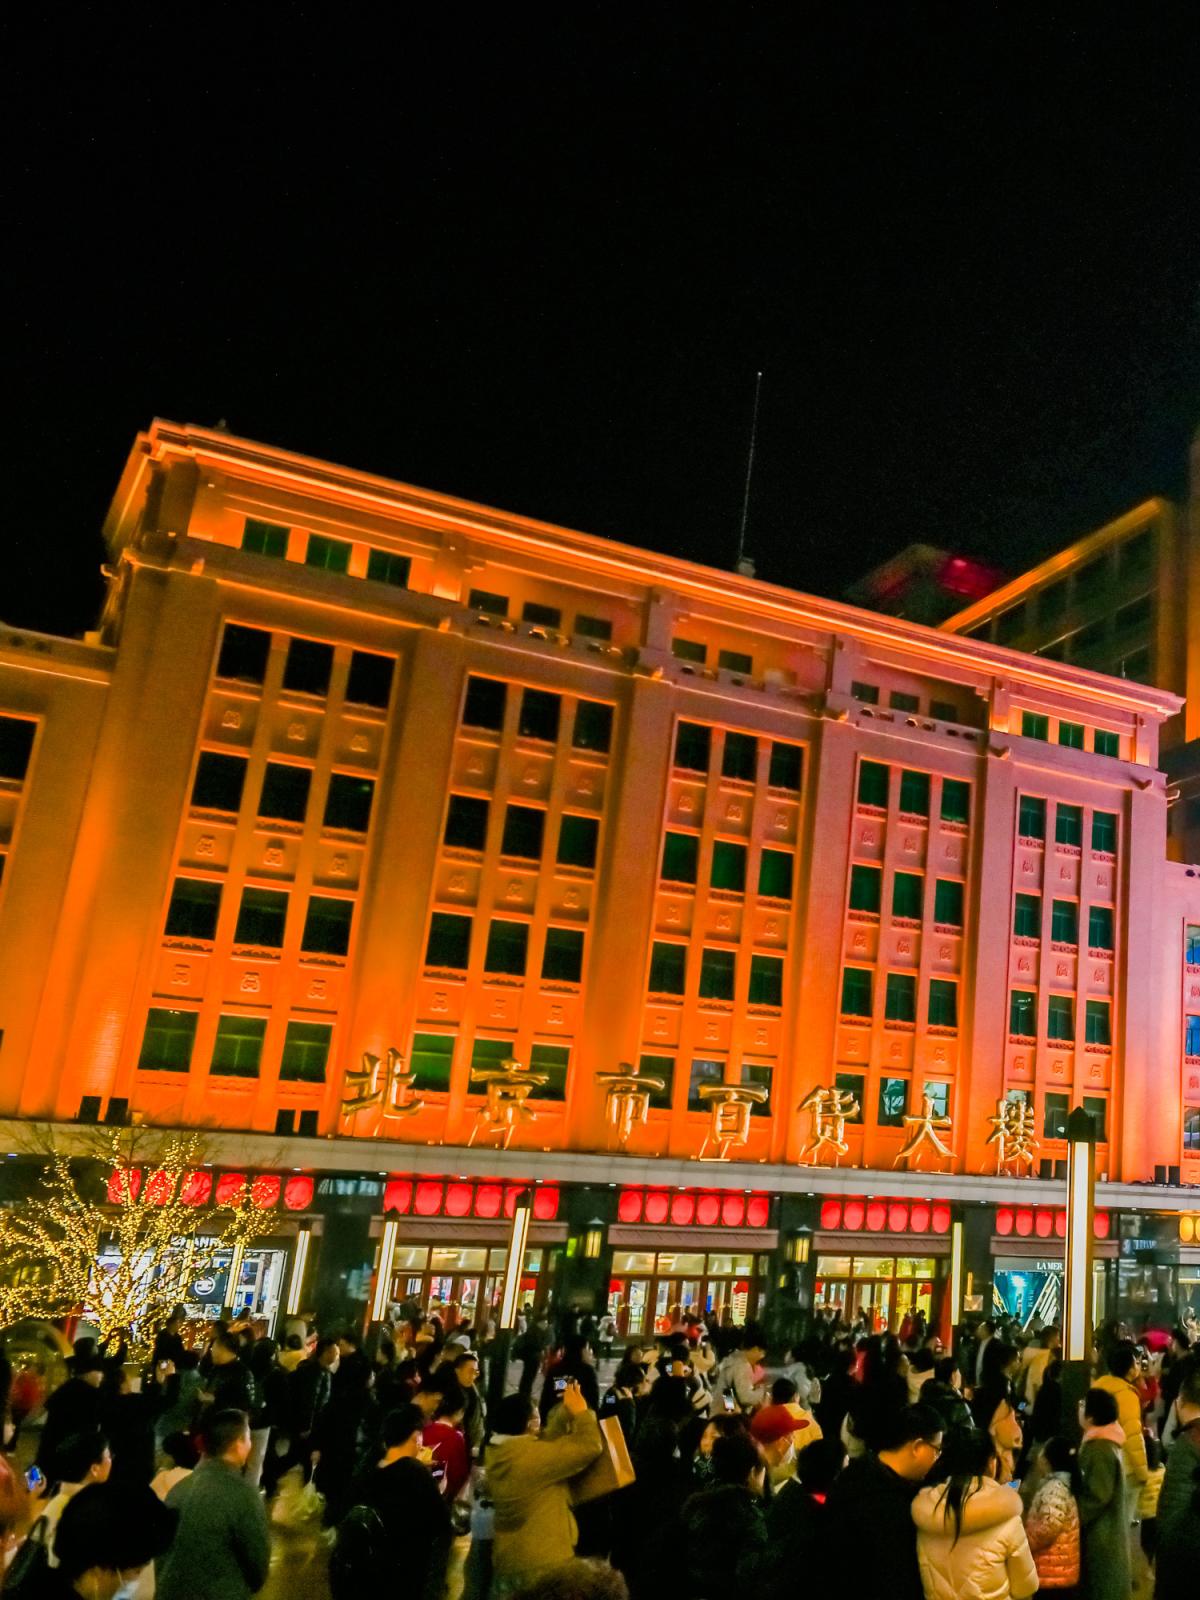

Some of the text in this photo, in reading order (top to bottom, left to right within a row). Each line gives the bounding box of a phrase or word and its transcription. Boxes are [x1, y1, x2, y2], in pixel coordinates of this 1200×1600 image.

[341, 1048, 1040, 1165] 北京市百货大楼
[1036, 1262, 1064, 1271] LA MER
